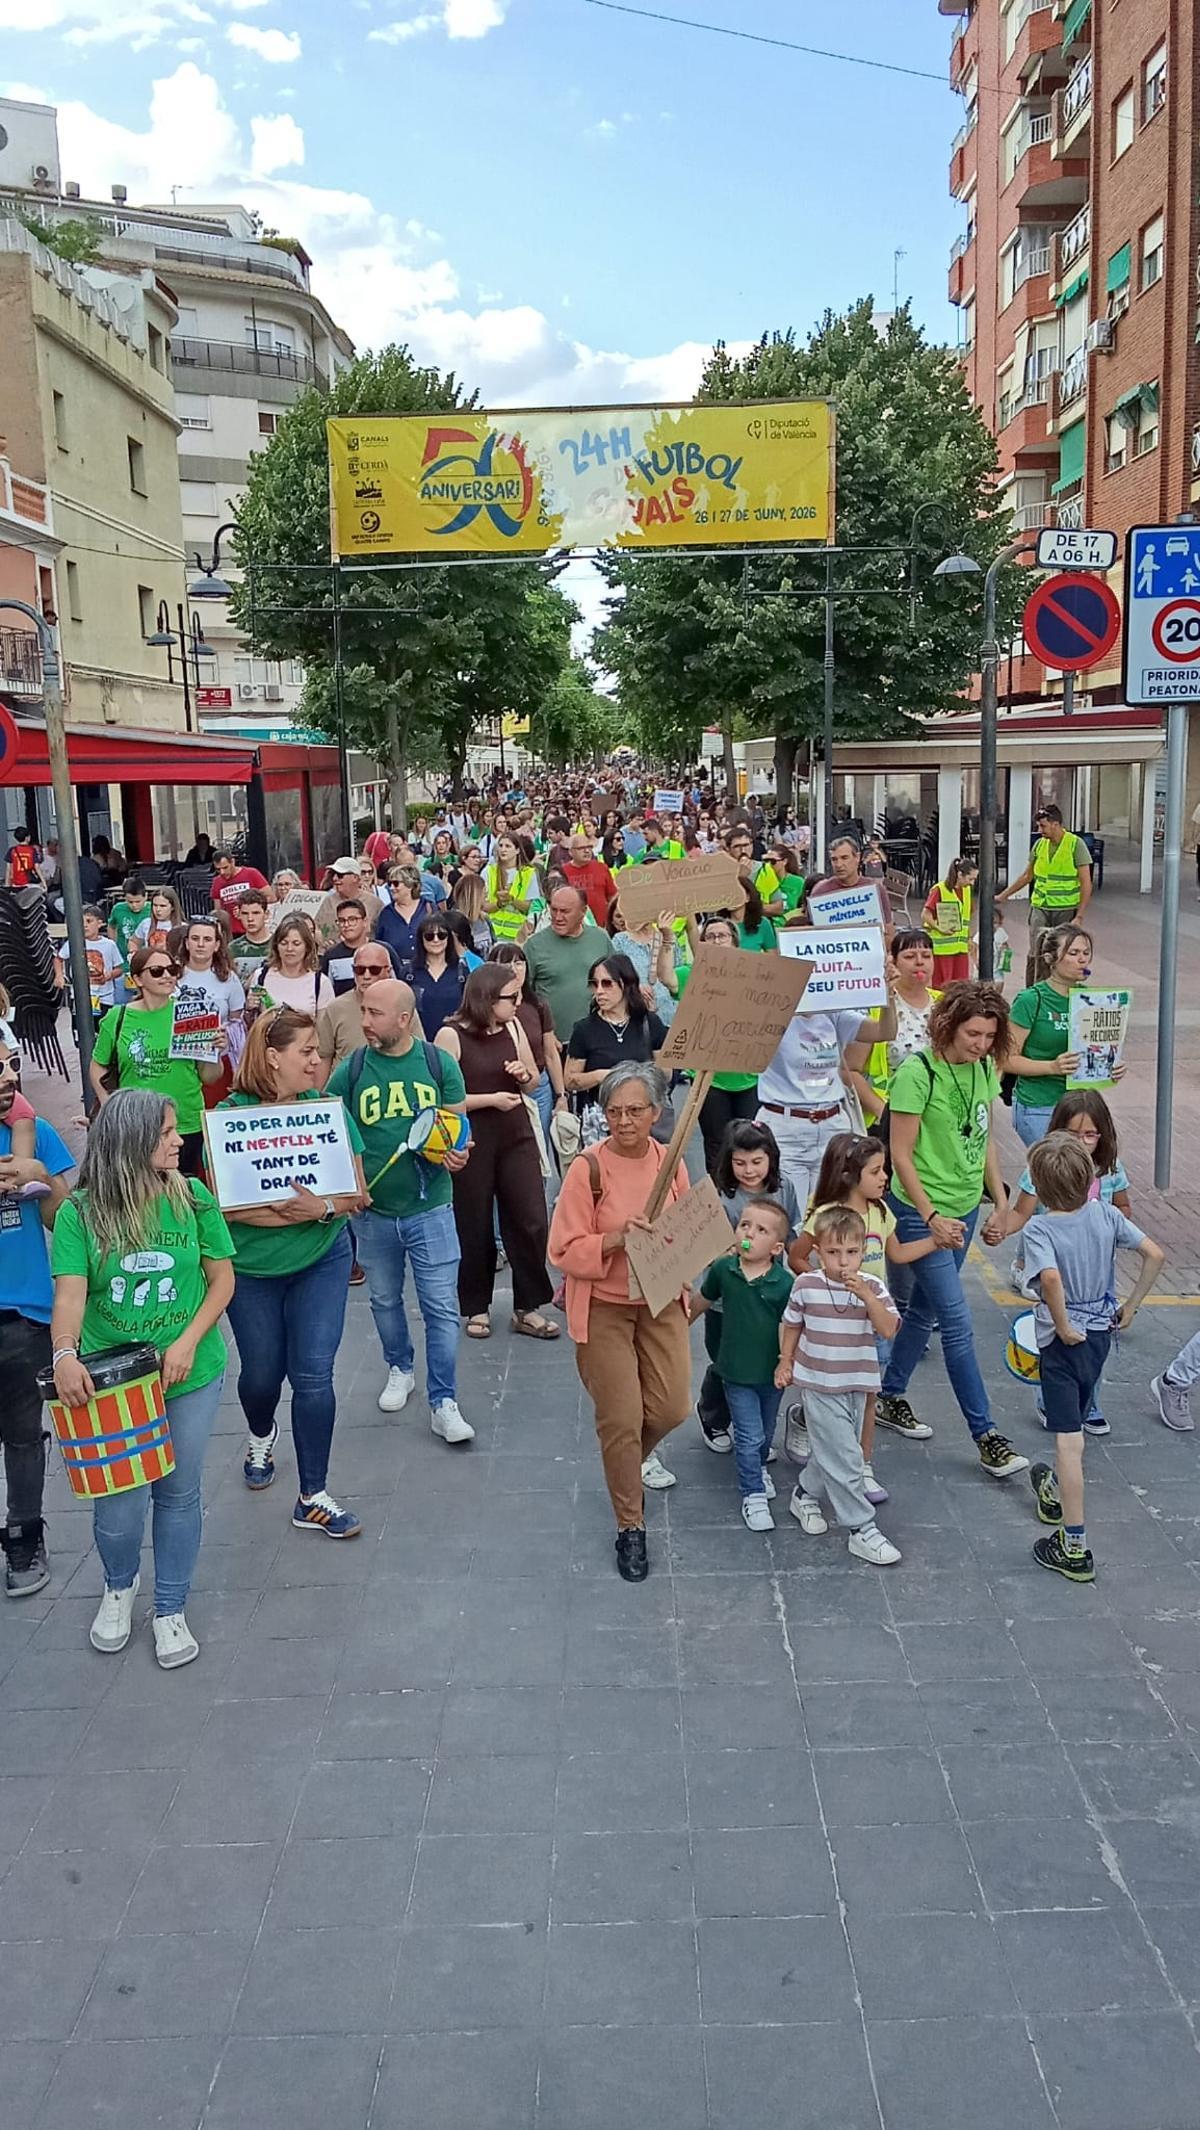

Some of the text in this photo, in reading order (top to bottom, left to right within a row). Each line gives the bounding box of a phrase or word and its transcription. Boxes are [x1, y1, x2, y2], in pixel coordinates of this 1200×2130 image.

[770, 418, 810, 428] Diputació
[770, 430, 817, 439] de València
[559, 426, 632, 476] 24H
[632, 441, 743, 491] FUTBOL
[420, 479, 521, 502] ANIVERSARI
[694, 510, 709, 524] 26
[720, 509, 732, 523] 27
[735, 509, 750, 521] DE
[753, 508, 787, 521] JUNY,
[790, 506, 817, 519] 2026
[1056, 534, 1099, 547] DE 17
[1047, 549, 1105, 563] A 06 H.
[1165, 616, 1200, 643] 20
[1147, 670, 1200, 682] PRIORID
[1148, 684, 1200, 696] PEATON
[796, 941, 871, 956] LA NOSTRA
[807, 977, 881, 993] SEU FUTUR
[176, 1003, 202, 1014] VAGA
[225, 1120, 247, 1133] 30
[250, 1117, 282, 1132] PER
[225, 1129, 339, 1153] NI NETFLIX TÉ
[251, 1153, 321, 1171] TANT DE
[260, 1173, 318, 1190] DRAMA
[141, 1307, 190, 1333] PÚBLICA
